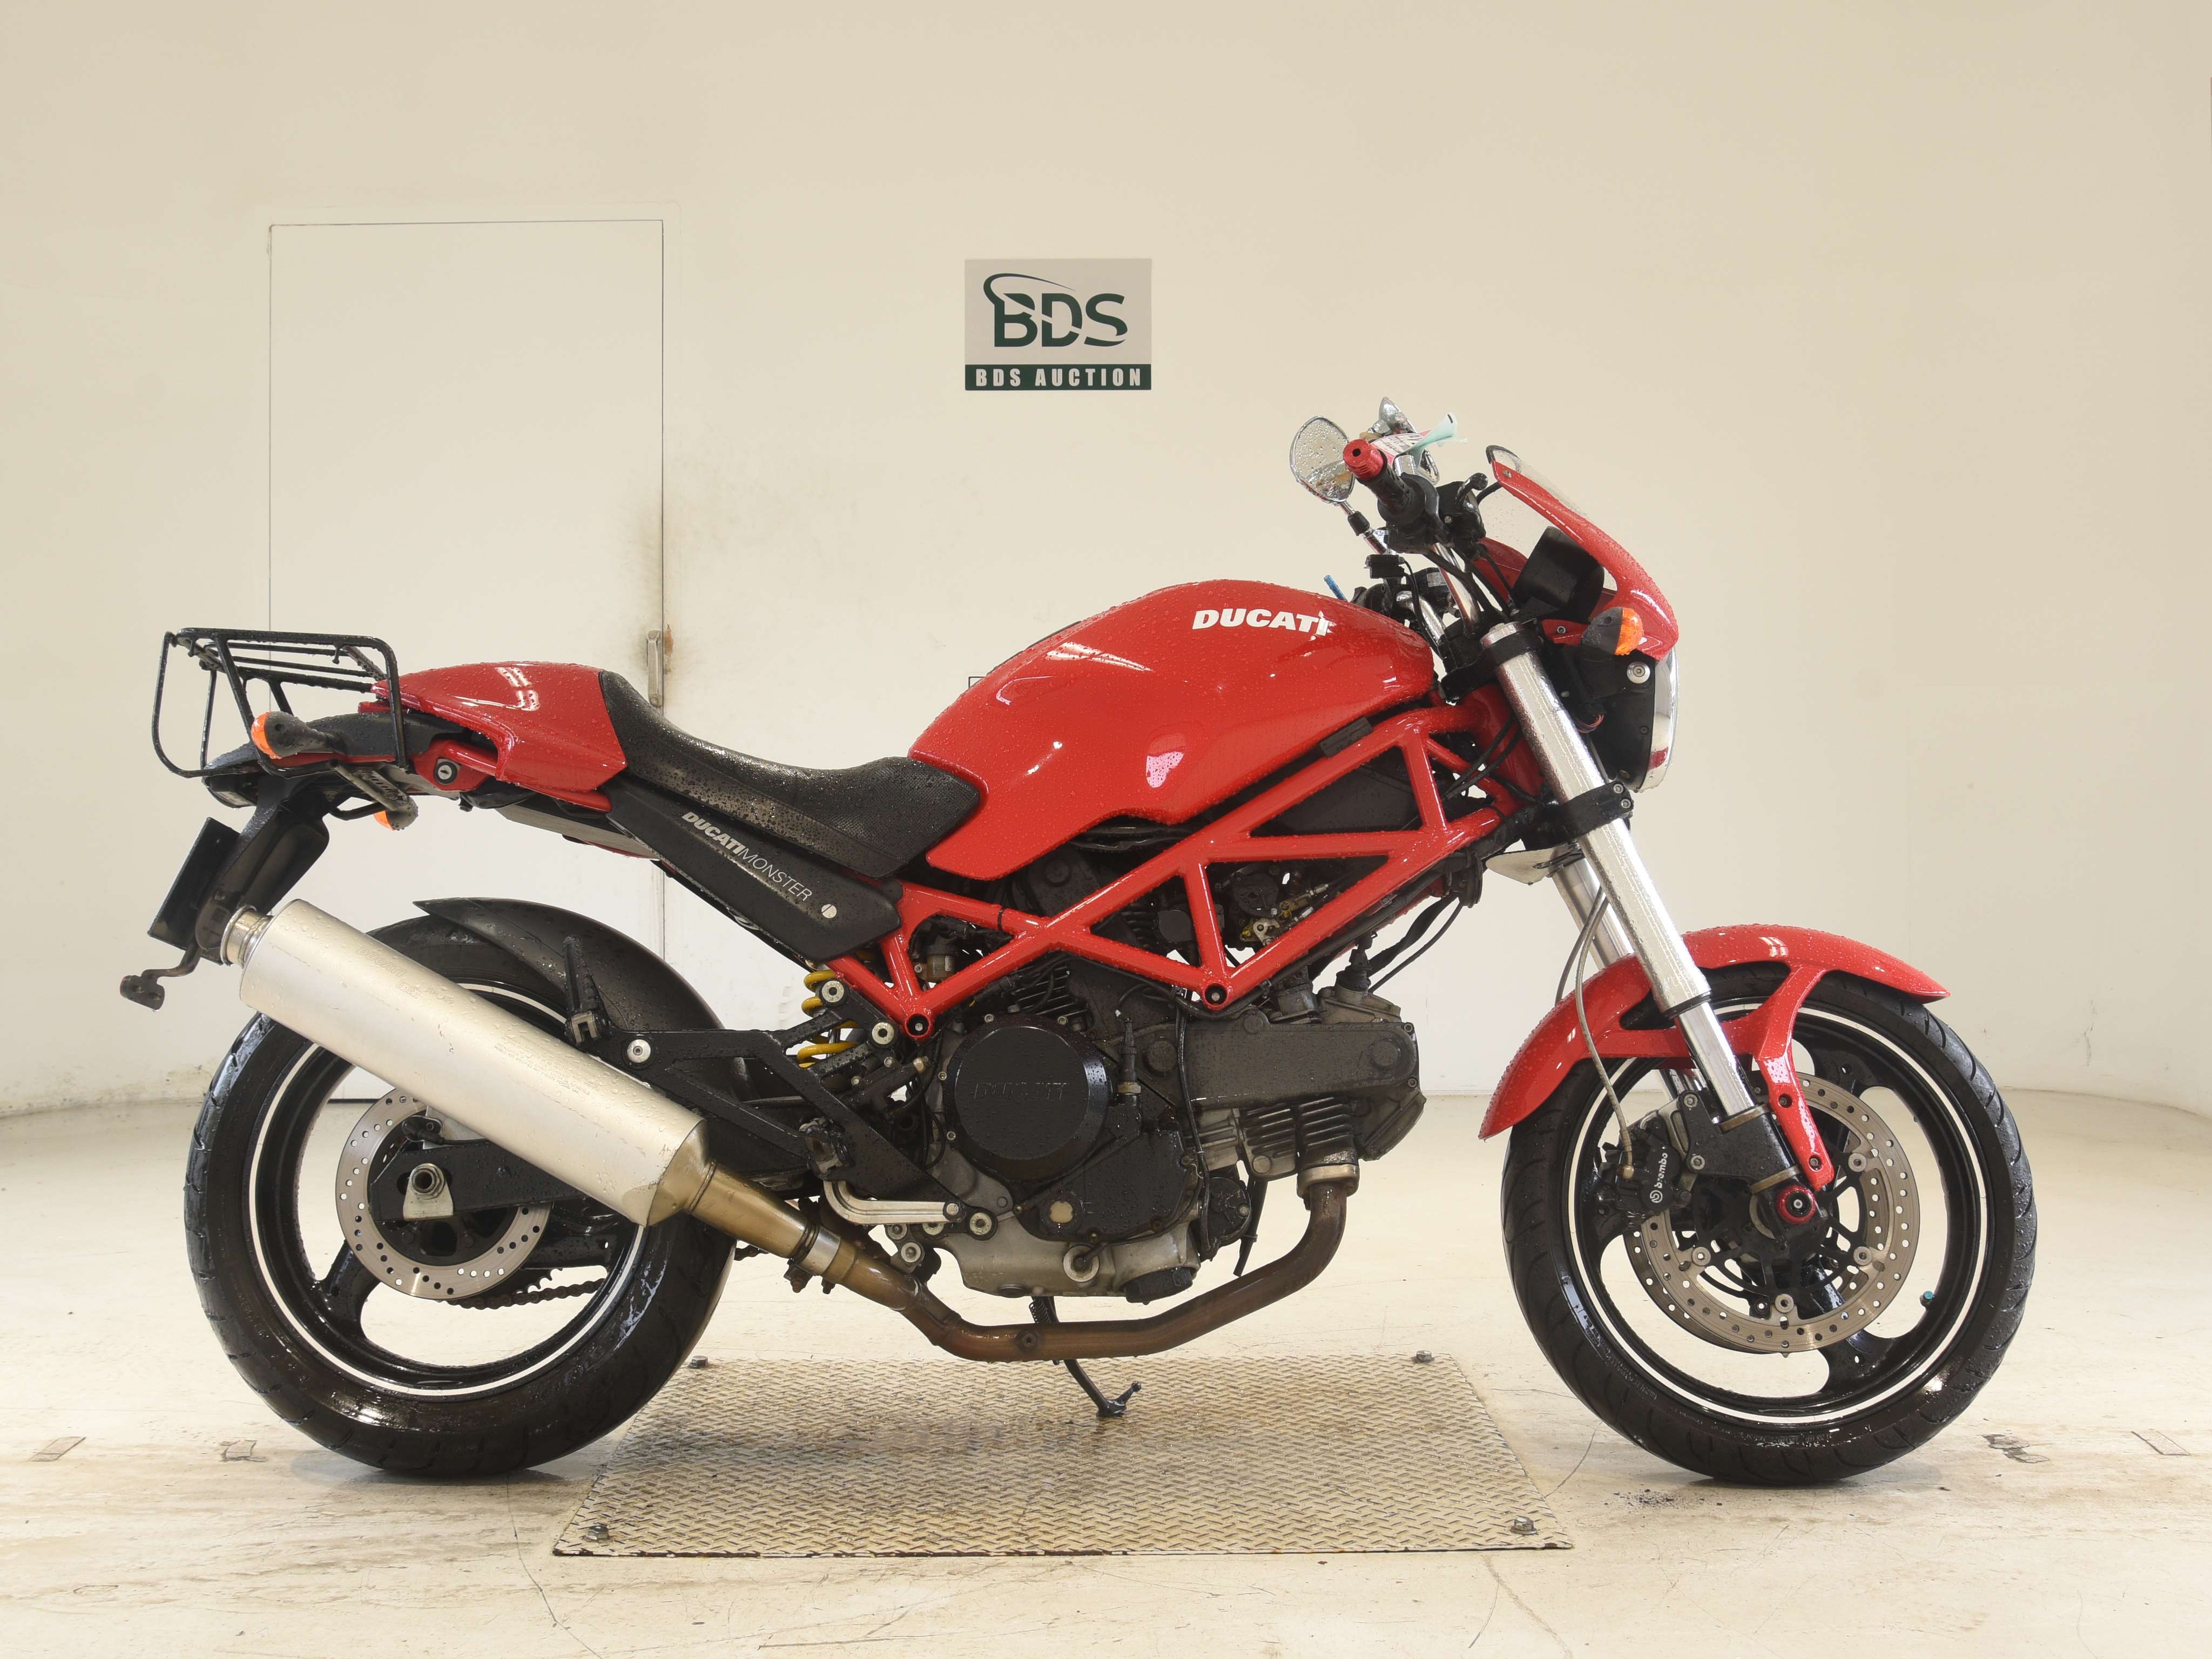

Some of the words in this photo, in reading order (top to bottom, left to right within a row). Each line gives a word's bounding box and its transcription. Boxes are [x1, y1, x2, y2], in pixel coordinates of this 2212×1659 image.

[983, 273, 1128, 347] BDS
[975, 368, 1021, 387] BDS
[1035, 368, 1141, 387] AUCTION
[1192, 608, 1330, 636] DUCATI
